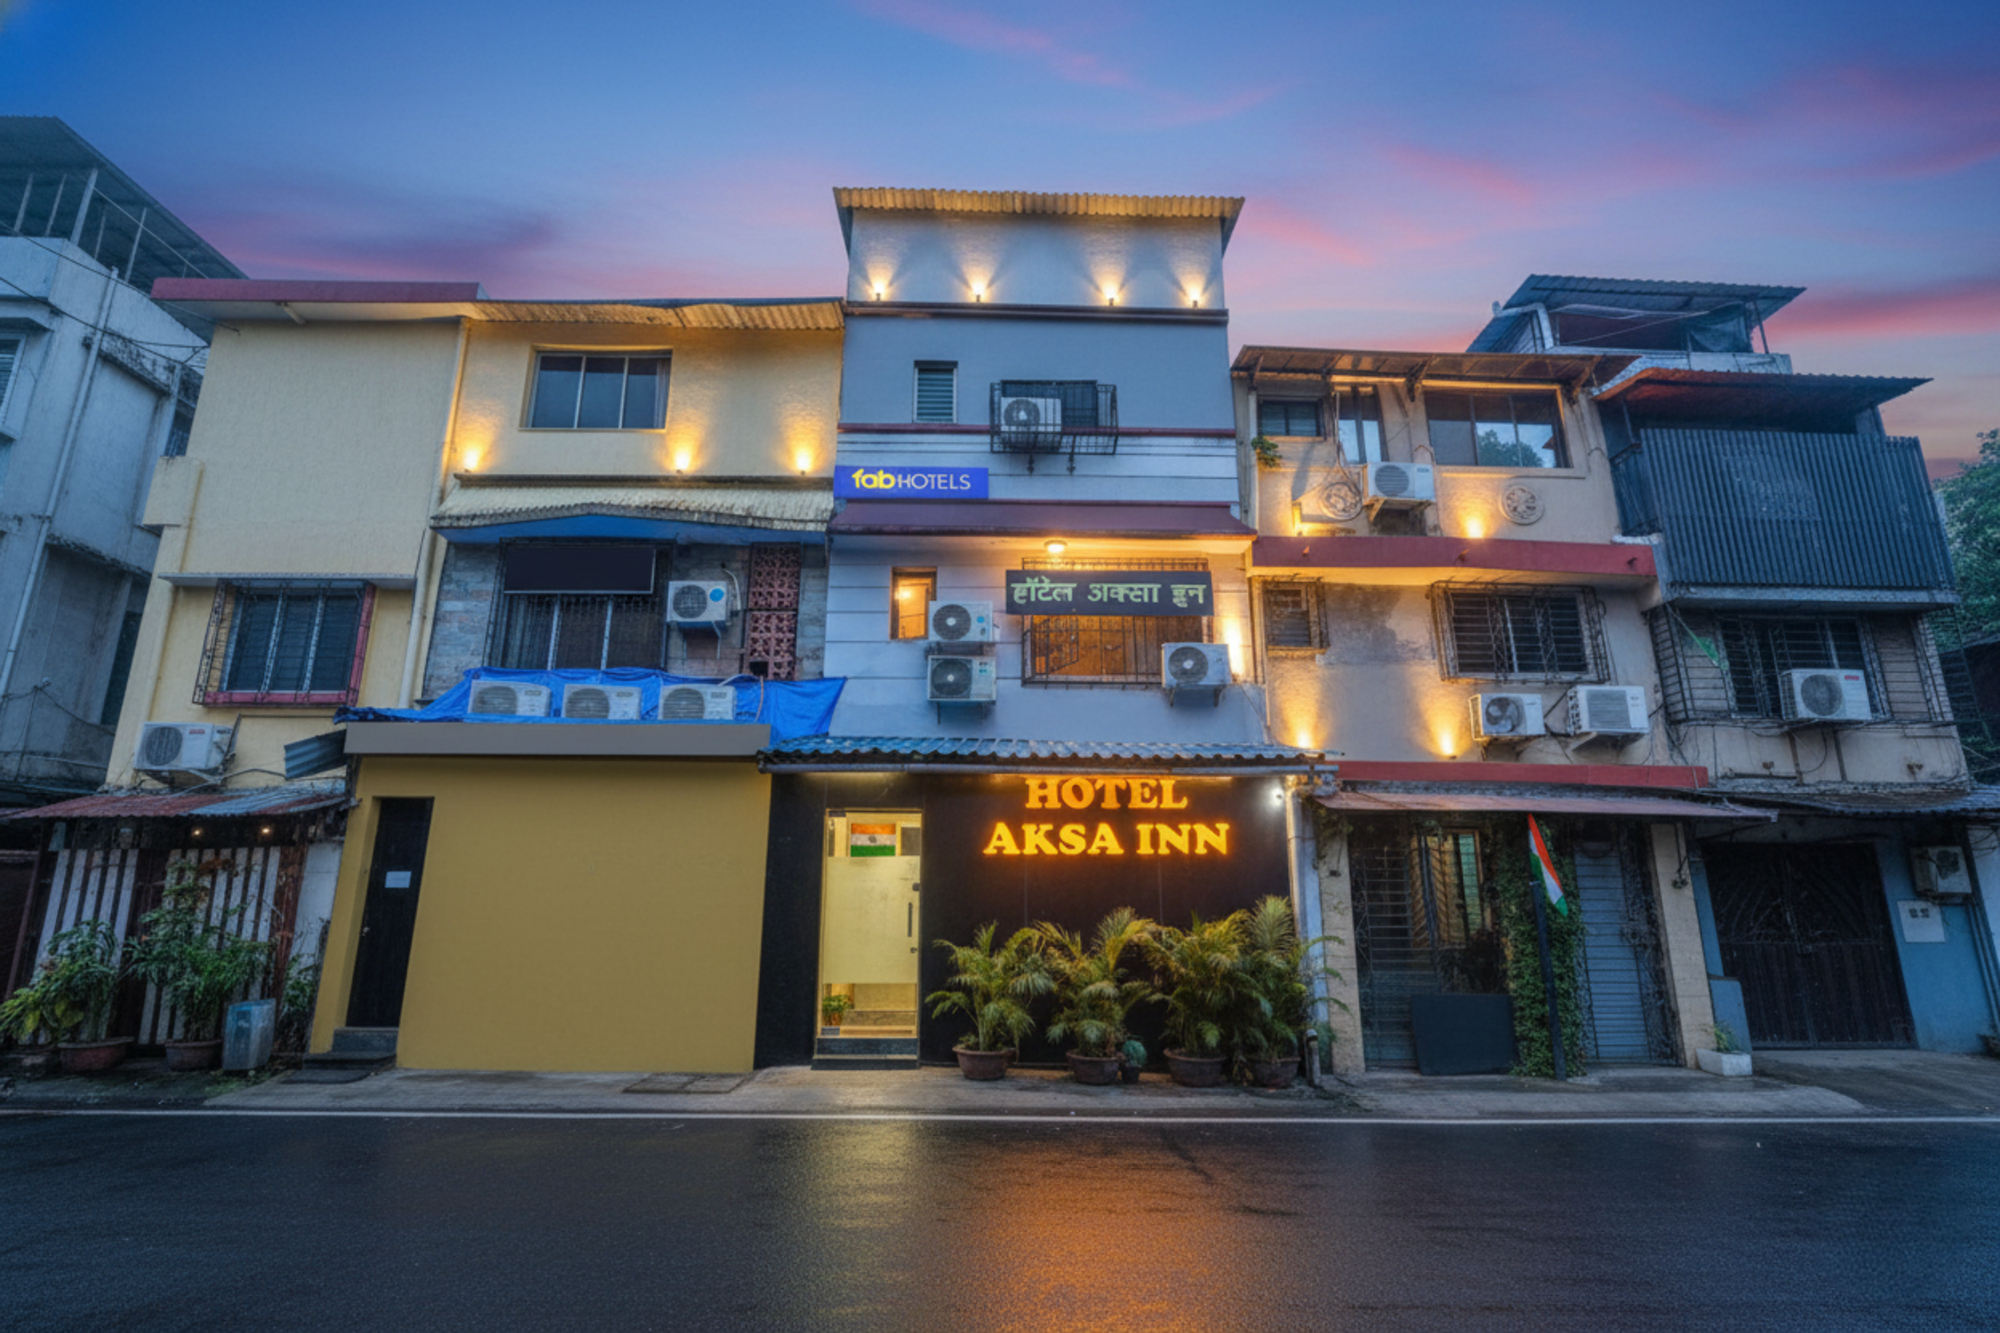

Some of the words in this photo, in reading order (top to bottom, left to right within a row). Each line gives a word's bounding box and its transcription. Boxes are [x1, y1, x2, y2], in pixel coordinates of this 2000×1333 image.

[1010, 575, 1077, 604] हॉटेल
[1087, 583, 1162, 603] अक्सा
[1170, 584, 1207, 608] इन
[1025, 777, 1188, 809] HOTEL
[983, 822, 1124, 855] AKSA
[1136, 823, 1230, 855] INN
